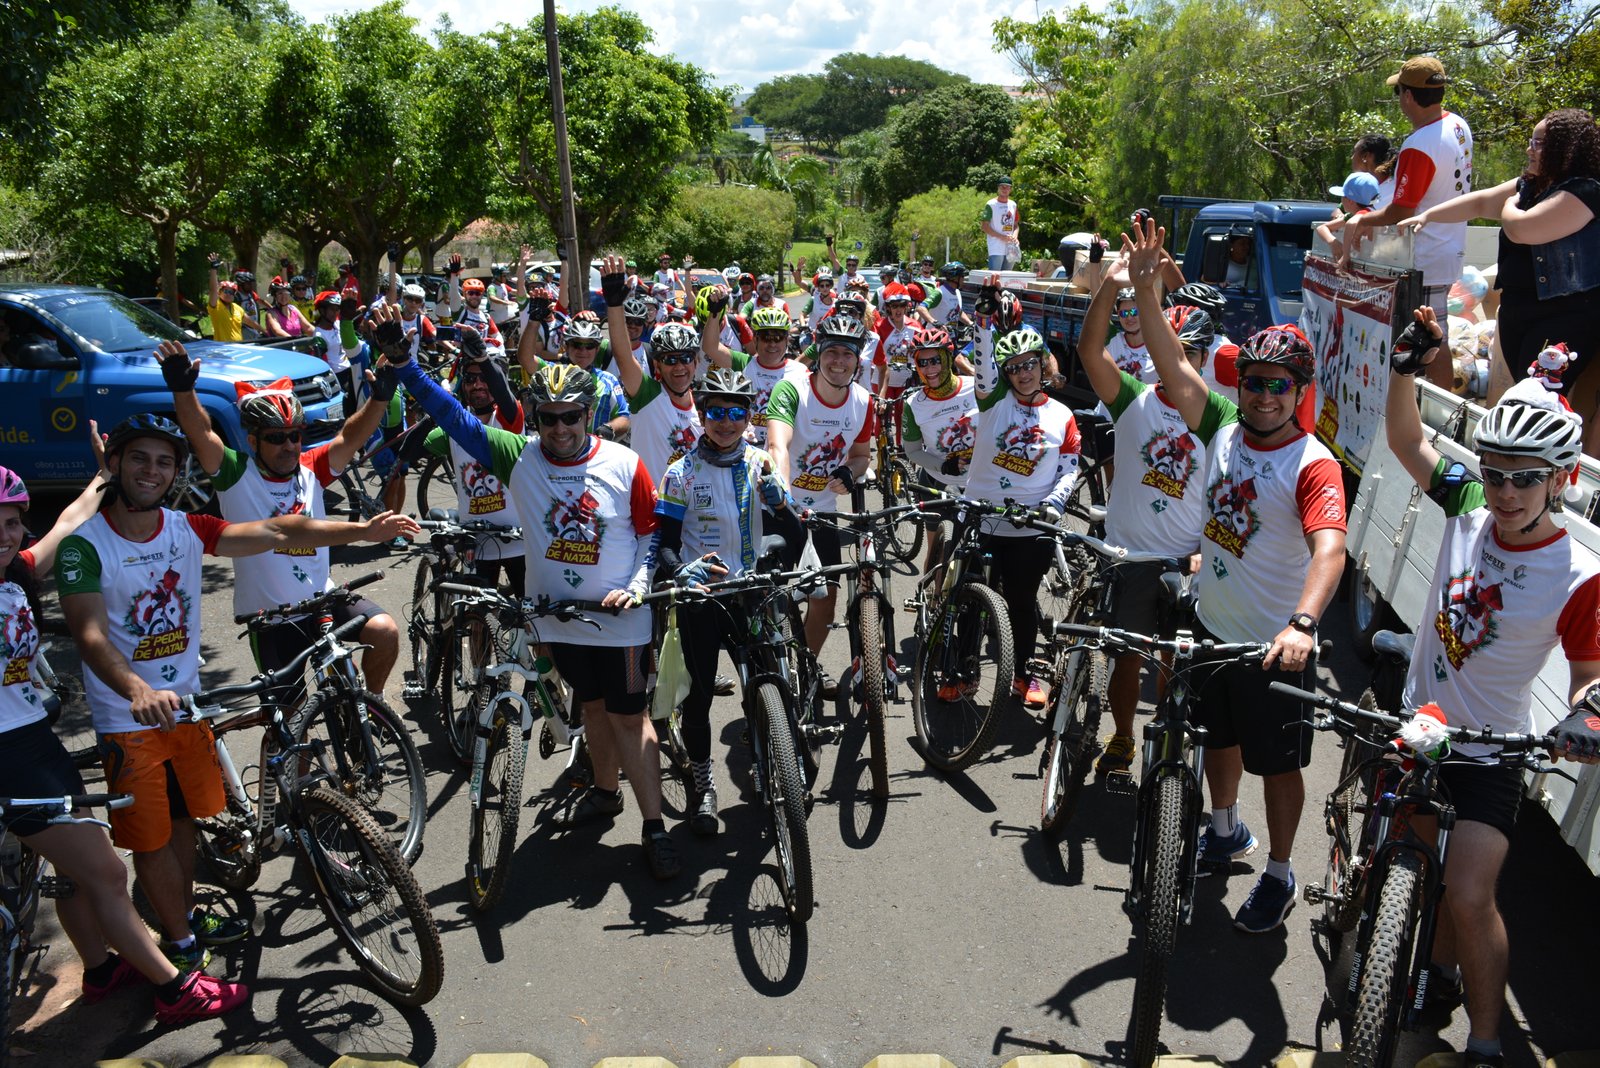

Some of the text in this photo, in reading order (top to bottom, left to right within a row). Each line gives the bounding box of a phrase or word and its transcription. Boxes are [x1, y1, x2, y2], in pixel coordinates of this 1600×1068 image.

[1005, 462, 1031, 476] NATAL
[477, 494, 503, 505] PEDAL
[478, 502, 504, 513] NATAL
[564, 542, 597, 553] PEDAL
[546, 548, 596, 564] DE NATAL
[1503, 576, 1526, 591] RENAULT
[153, 630, 187, 647] PEDAL
[134, 643, 187, 660] DE NATAL
[1413, 969, 1430, 1010] ROCKSHOX
